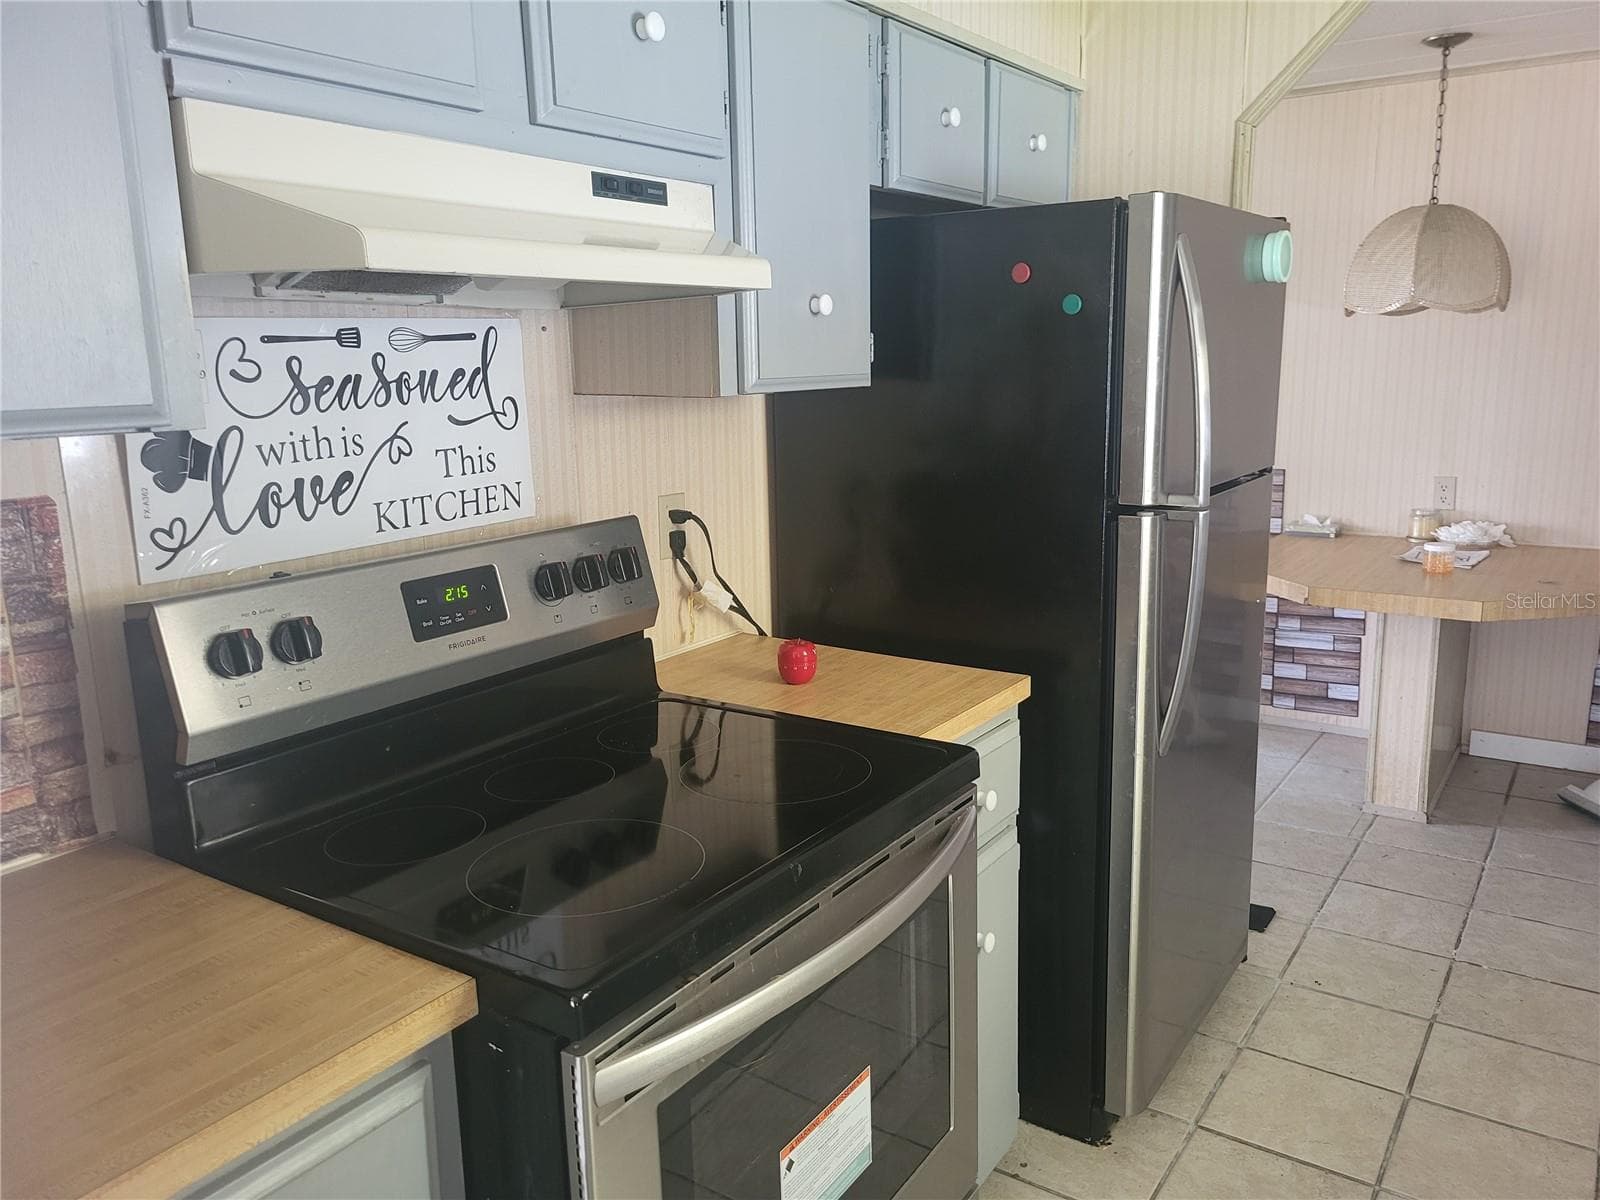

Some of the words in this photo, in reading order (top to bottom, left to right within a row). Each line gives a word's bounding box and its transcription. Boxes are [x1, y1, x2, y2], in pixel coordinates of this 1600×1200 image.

[256, 426, 334, 466] with
[341, 428, 365, 458] is
[435, 444, 497, 479] This
[198, 424, 370, 545] love
[373, 481, 523, 534] KITCHEN
[445, 585, 469, 602] 2:15
[448, 635, 487, 651] FRIGIDAIRE
